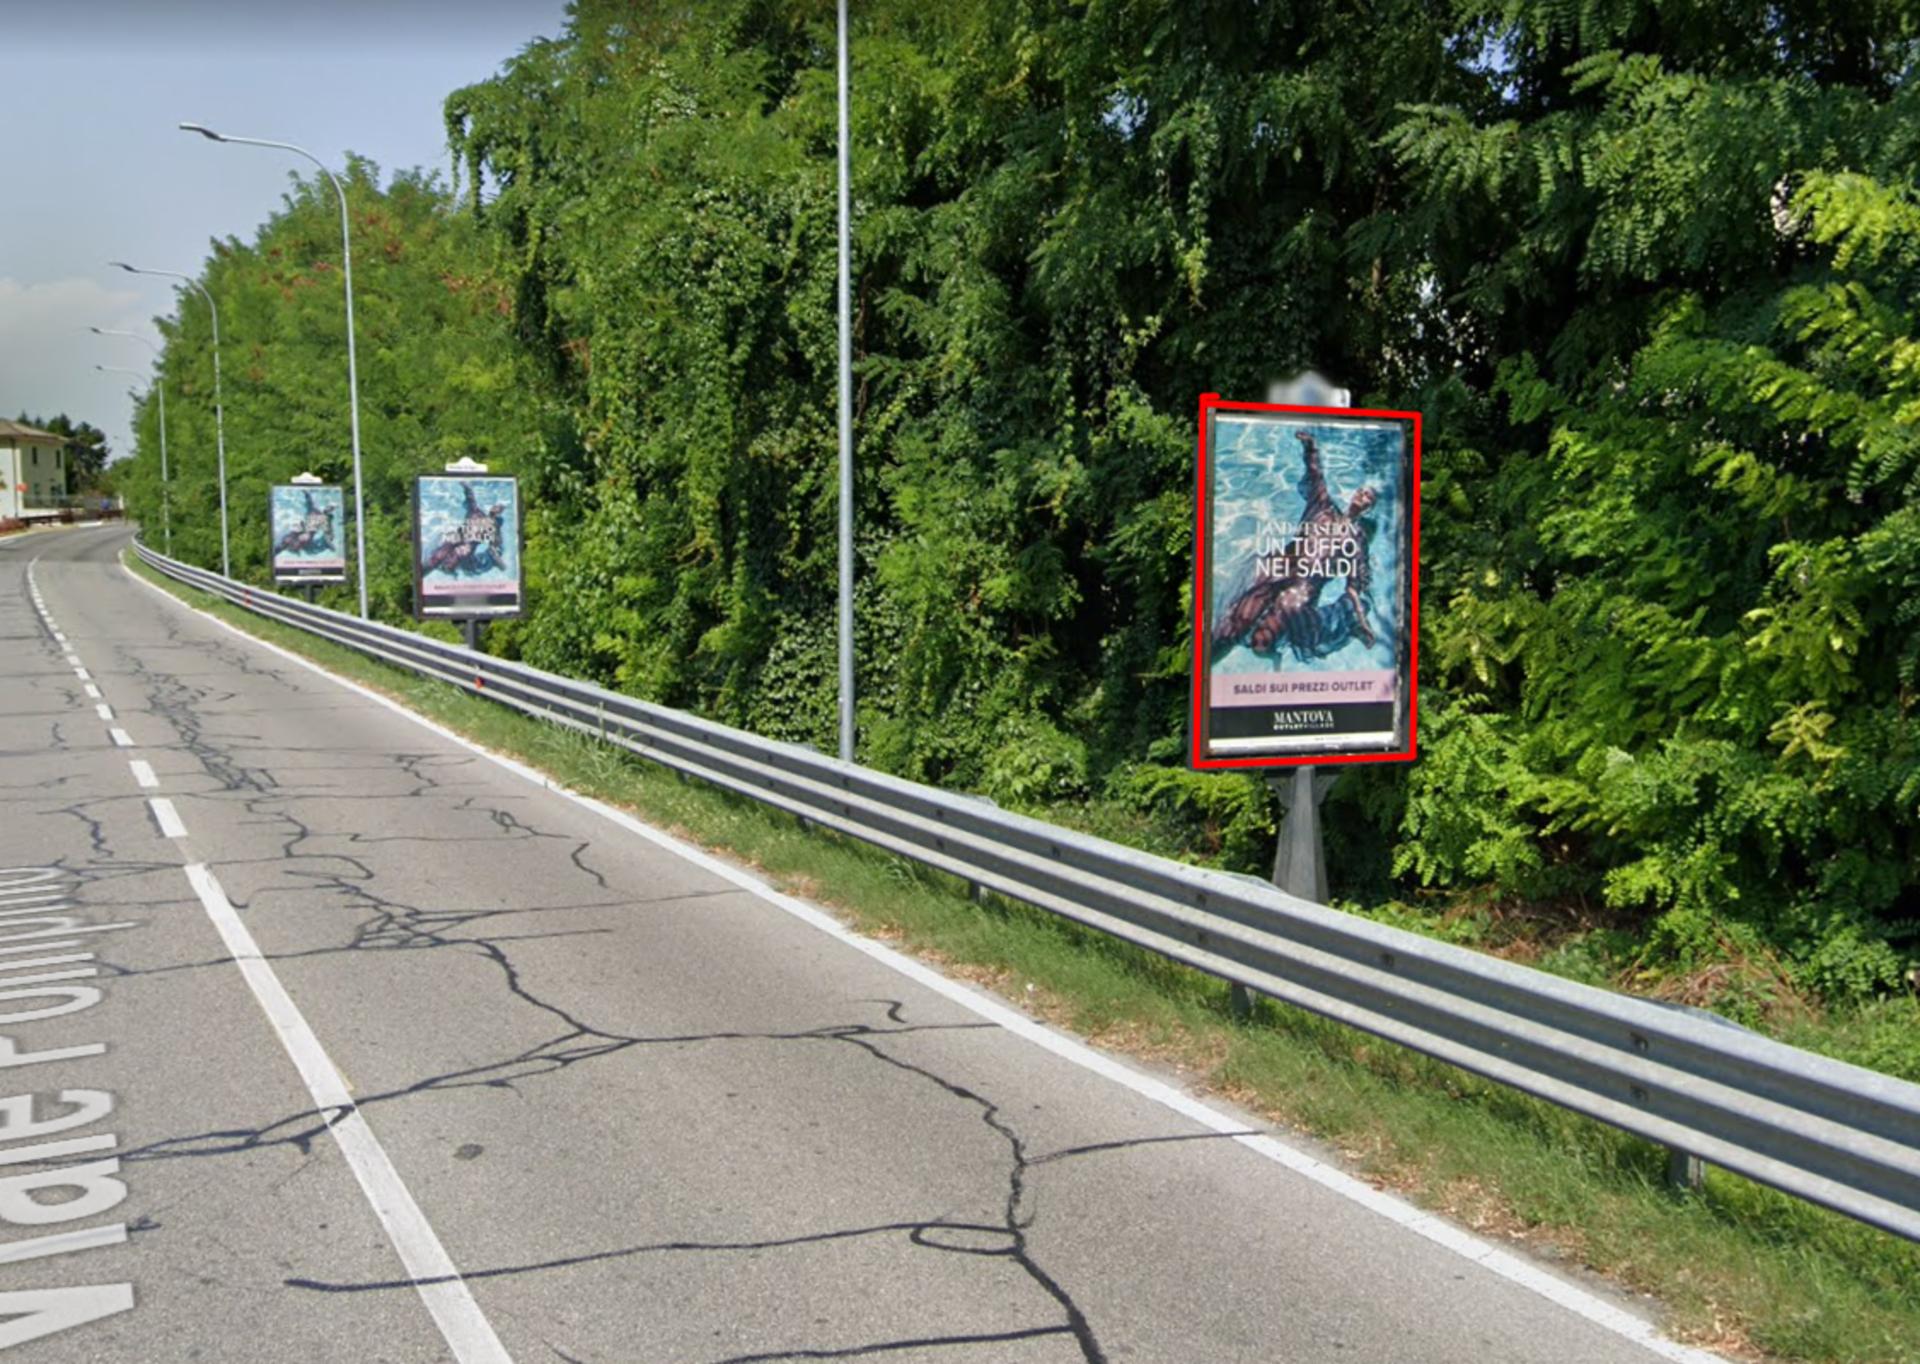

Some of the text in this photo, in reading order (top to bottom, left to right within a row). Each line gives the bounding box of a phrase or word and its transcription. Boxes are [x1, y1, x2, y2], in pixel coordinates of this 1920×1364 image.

[1256, 537, 1358, 557] UN TUFFO
[1256, 557, 1357, 578] NEI SALDI
[1233, 680, 1374, 695] SALDI SUI PREZZI OUTLET
[1273, 710, 1334, 724] MANTOVA
